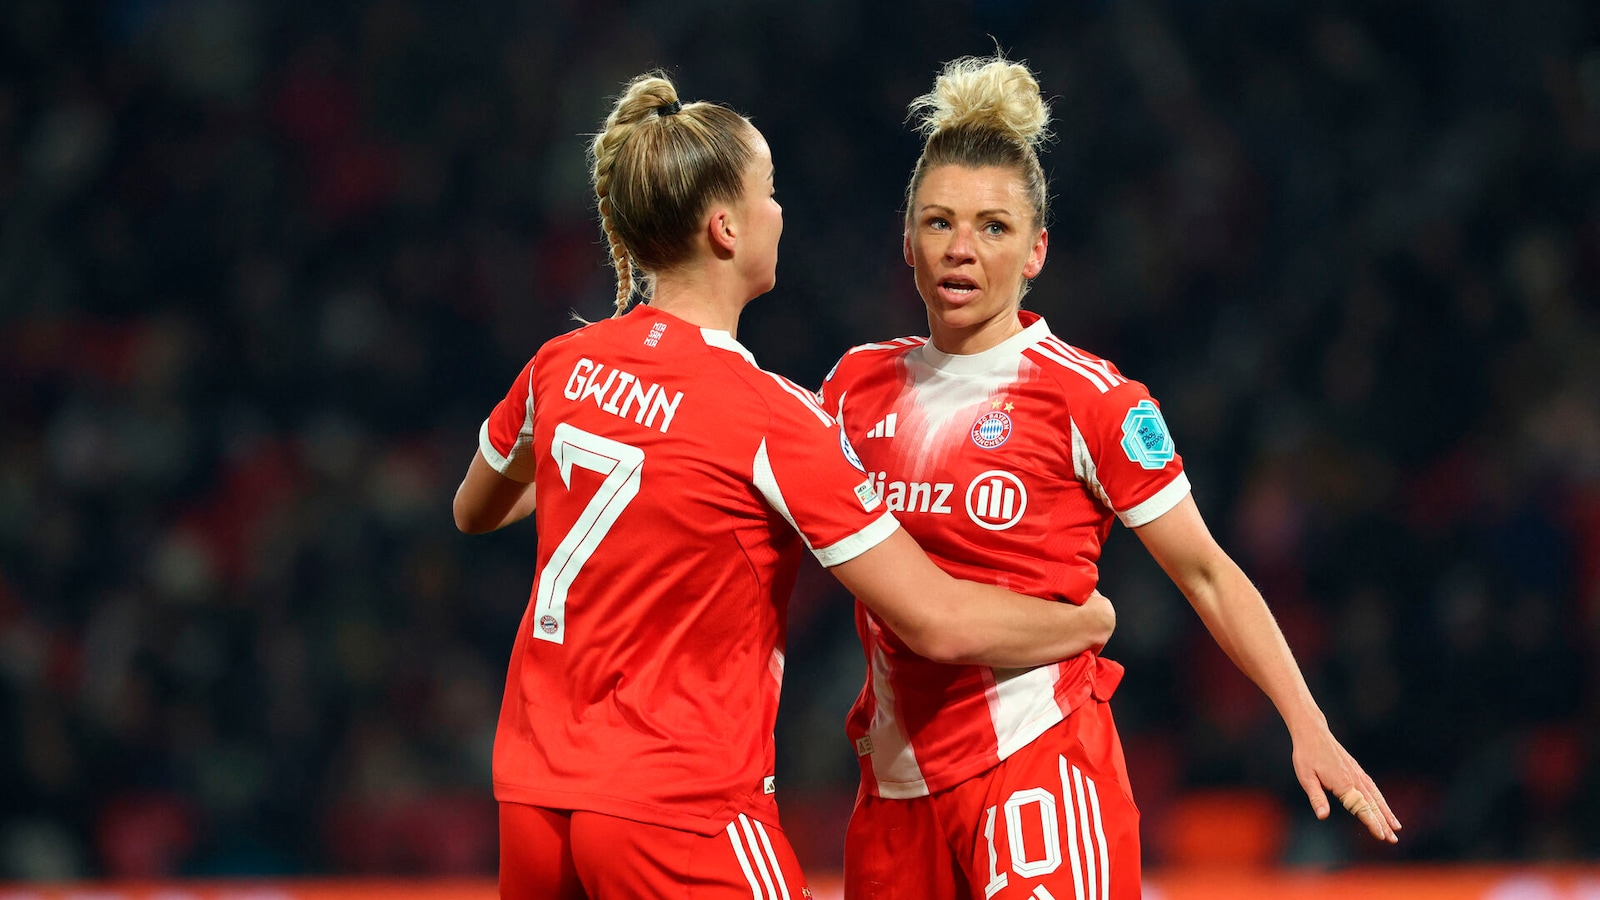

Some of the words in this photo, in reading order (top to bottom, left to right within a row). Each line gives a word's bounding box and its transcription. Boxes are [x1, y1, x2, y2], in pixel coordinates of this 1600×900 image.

[648, 330, 663, 340] SAN
[652, 322, 667, 332] MIA
[644, 338, 659, 348] MIA
[563, 358, 684, 434] GWINN
[989, 413, 1010, 430] BAYERN
[867, 471, 954, 514] lianz
[533, 422, 645, 645] 7
[984, 787, 1063, 900] 10
